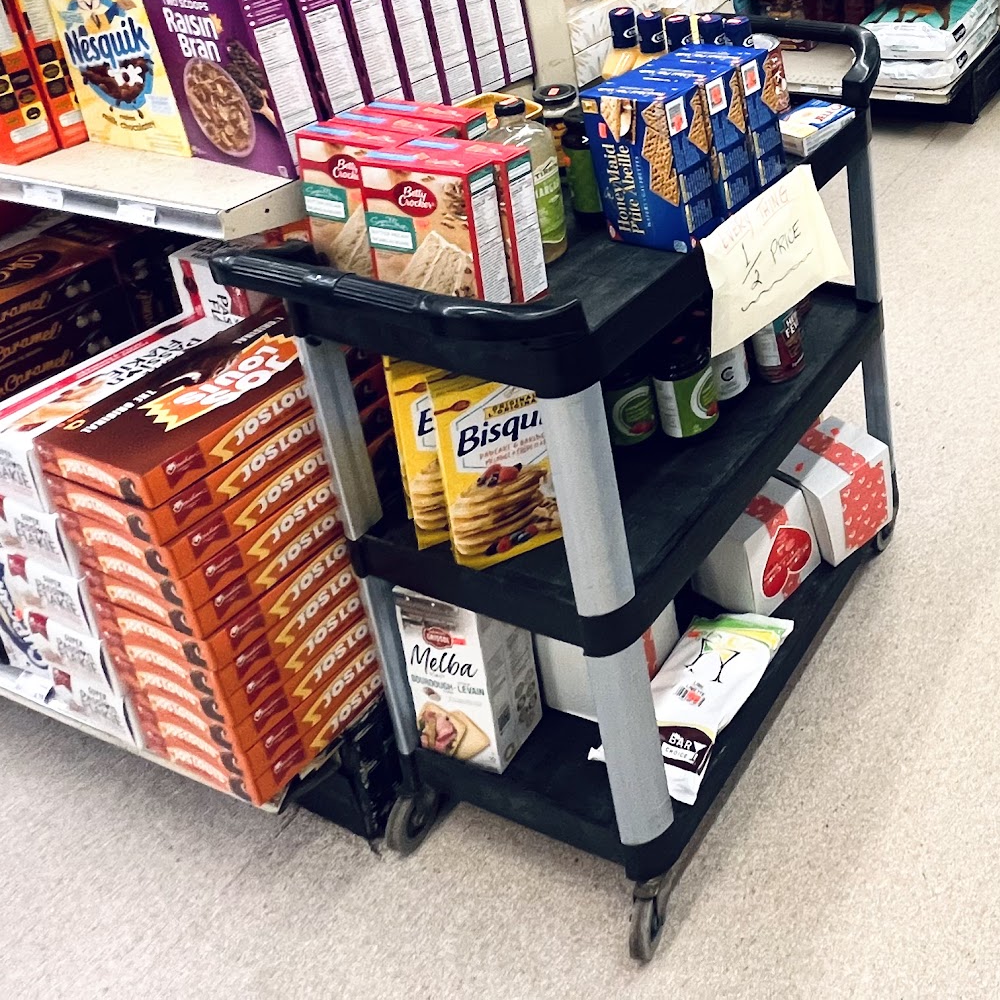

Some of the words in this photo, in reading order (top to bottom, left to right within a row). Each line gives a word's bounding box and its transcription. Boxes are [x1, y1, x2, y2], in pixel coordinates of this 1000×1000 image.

[64, 16, 150, 69] Nesquik
[162, 6, 219, 40] Raisin
[177, 33, 221, 62] Bran
[617, 145, 638, 196] Abeille
[398, 195, 432, 210] Crocker
[404, 186, 428, 202] Betty
[770, 219, 802, 264] PRICE
[173, 345, 278, 406] LOUIS
[200, 354, 294, 408] JOS
[133, 389, 158, 403] THE
[234, 408, 272, 446] JOS
[272, 384, 310, 416] LOU
[242, 444, 278, 482] JOS
[278, 418, 316, 452] LOU
[458, 410, 542, 457] Bisqu
[258, 475, 294, 514] JOS
[294, 453, 327, 482] LOU
[270, 504, 307, 544] JOS
[279, 532, 313, 572] JOS
[292, 562, 325, 602] JOS
[296, 589, 330, 630] JOS
[306, 615, 339, 656] JOS
[314, 642, 346, 684] JOS
[410, 644, 478, 678] Melba
[323, 668, 355, 709] JOS
[411, 674, 454, 692] SOURDOUGH
[457, 684, 485, 696] LEVAIN
[330, 694, 362, 734] JOS
[665, 746, 688, 758] CHOICE
[668, 732, 692, 750] BAR
